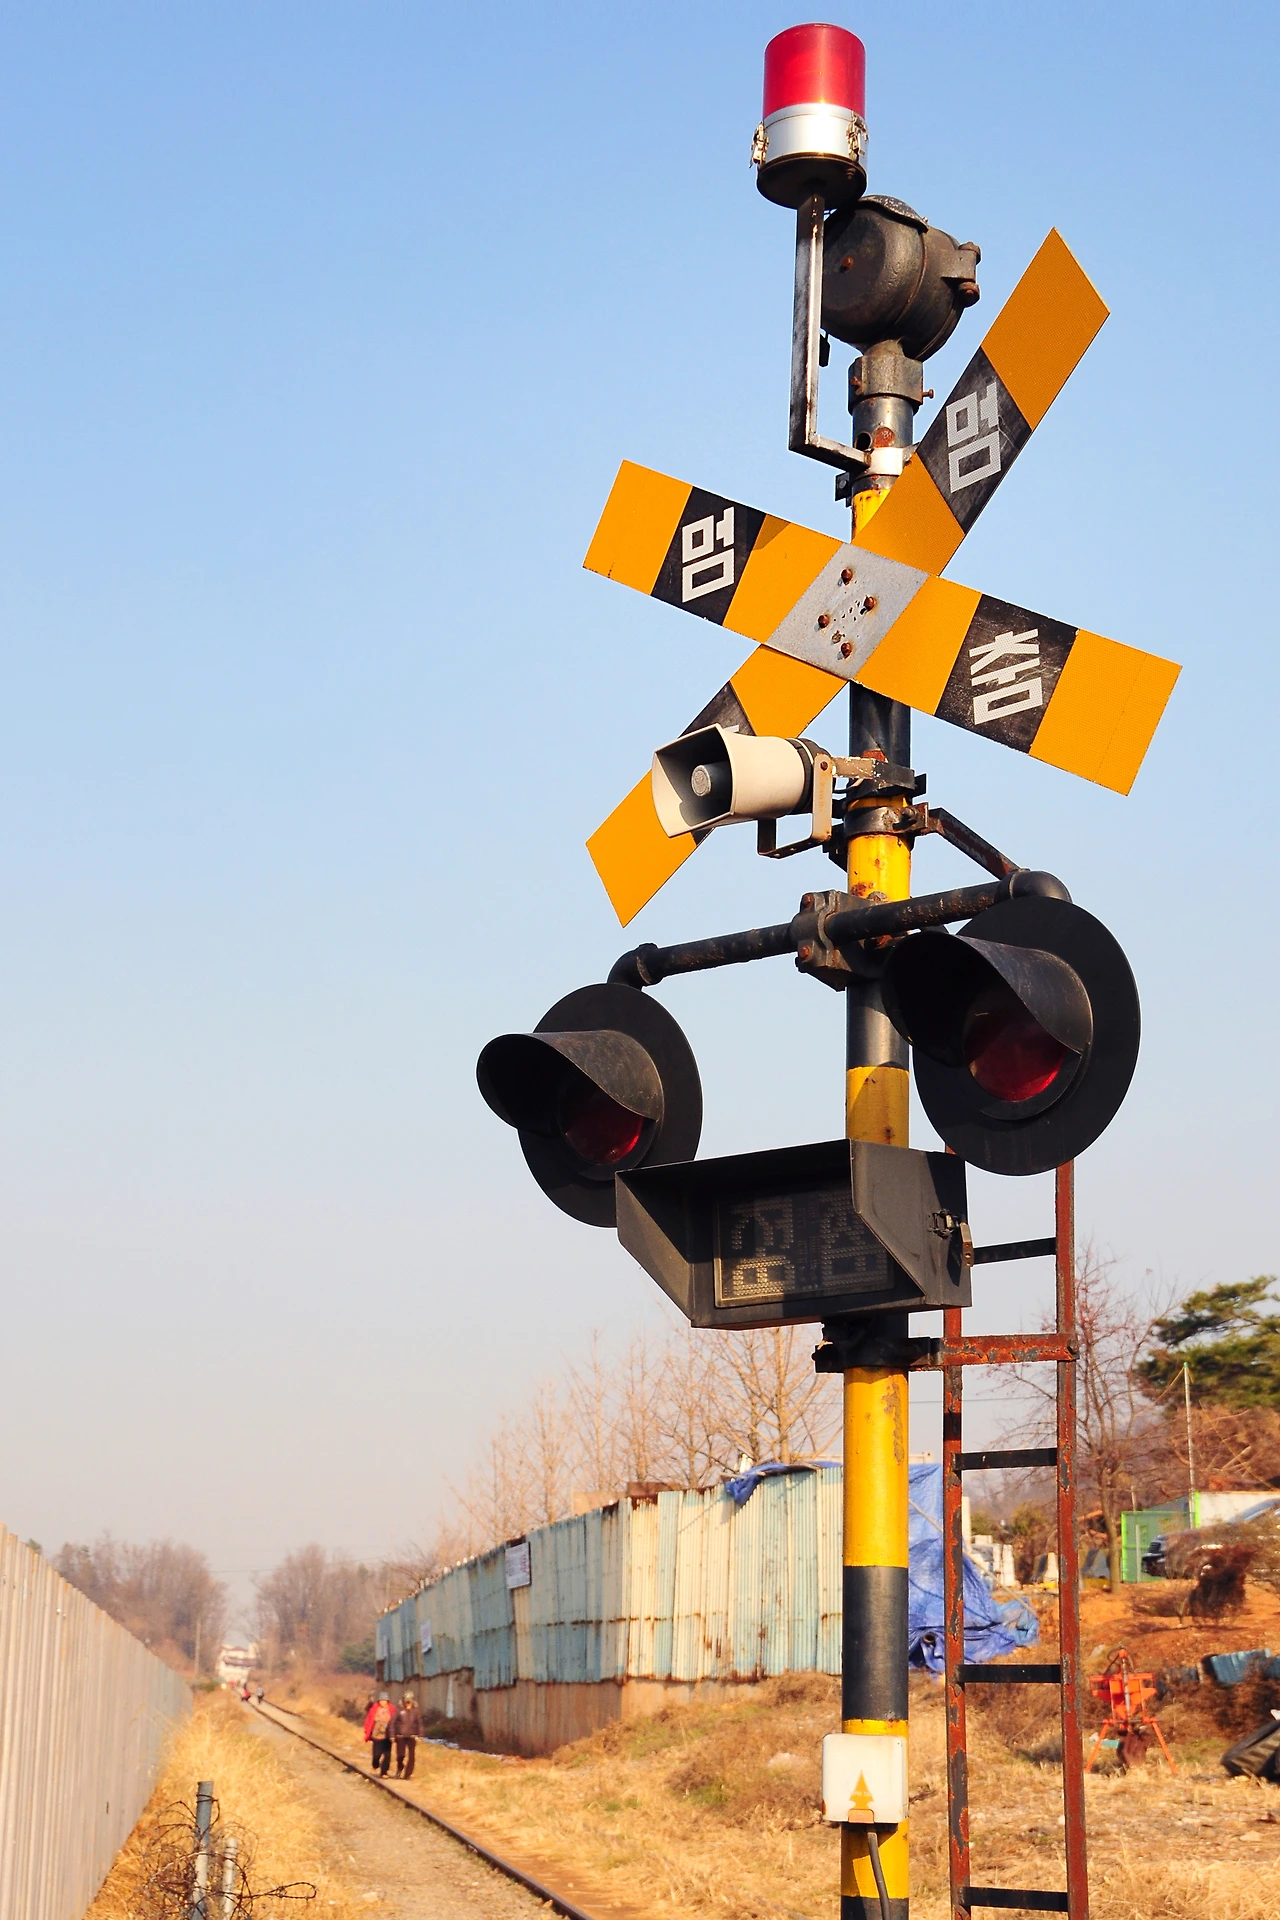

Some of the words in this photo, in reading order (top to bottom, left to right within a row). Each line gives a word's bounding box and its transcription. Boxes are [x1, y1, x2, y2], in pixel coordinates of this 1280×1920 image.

[946, 381, 1002, 494] 멈
[681, 506, 735, 603] 멈
[968, 628, 1043, 725] 춤
